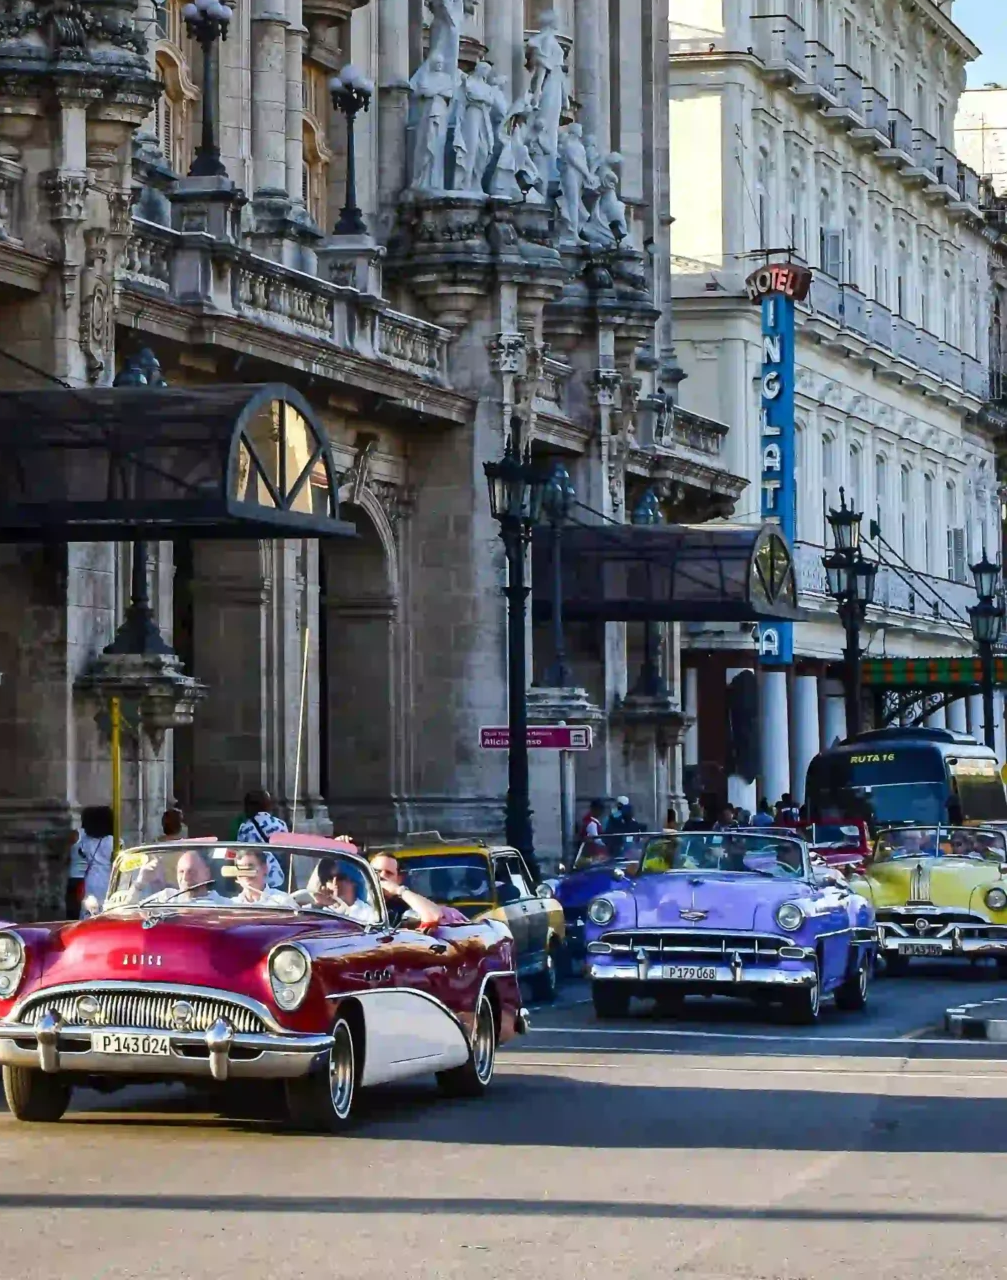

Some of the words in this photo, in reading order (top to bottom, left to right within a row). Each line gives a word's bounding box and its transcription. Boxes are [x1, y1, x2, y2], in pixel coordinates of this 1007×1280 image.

[746, 267, 794, 301] HOTEL
[760, 300, 782, 655] INGLATA
[850, 754, 880, 764] RUTA
[882, 753, 895, 762] 16
